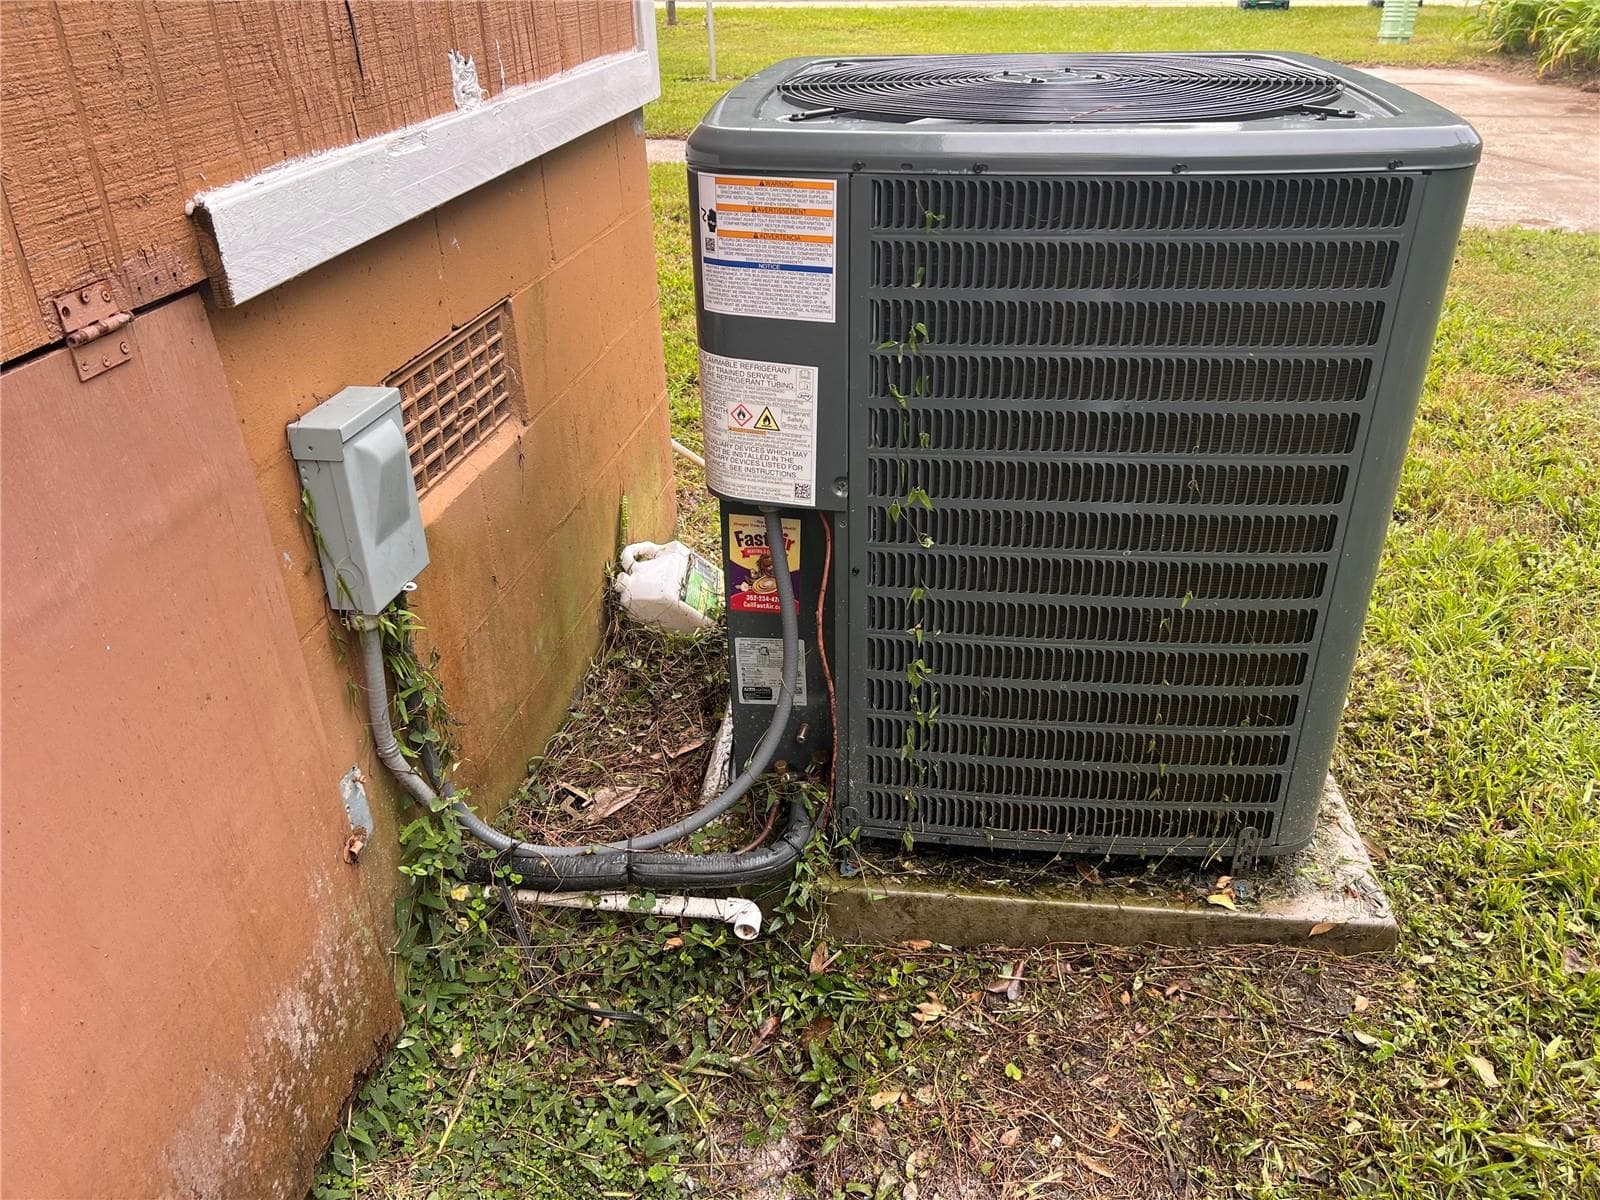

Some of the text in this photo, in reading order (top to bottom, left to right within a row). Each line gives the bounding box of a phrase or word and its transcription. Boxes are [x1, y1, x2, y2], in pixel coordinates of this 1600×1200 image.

[758, 207, 806, 215] AVERTISSEMENT
[760, 233, 801, 241] ADVERTENCIA
[716, 366, 744, 377] TRAINED
[747, 373, 778, 381] SERVICE
[740, 362, 791, 374] REFRIGERANT
[717, 374, 764, 386] REFRIGERANT
[767, 381, 794, 389] TUBING
[732, 450, 769, 460] INSTALLED
[771, 454, 778, 462] IN
[781, 456, 794, 464] THE
[734, 445, 765, 454] DEVICES
[767, 448, 790, 457] WHICH
[792, 451, 808, 459] MAY
[729, 464, 742, 472] SEE
[730, 457, 760, 466] DEVICES
[761, 460, 786, 469] LISTED
[788, 463, 803, 471] FOR
